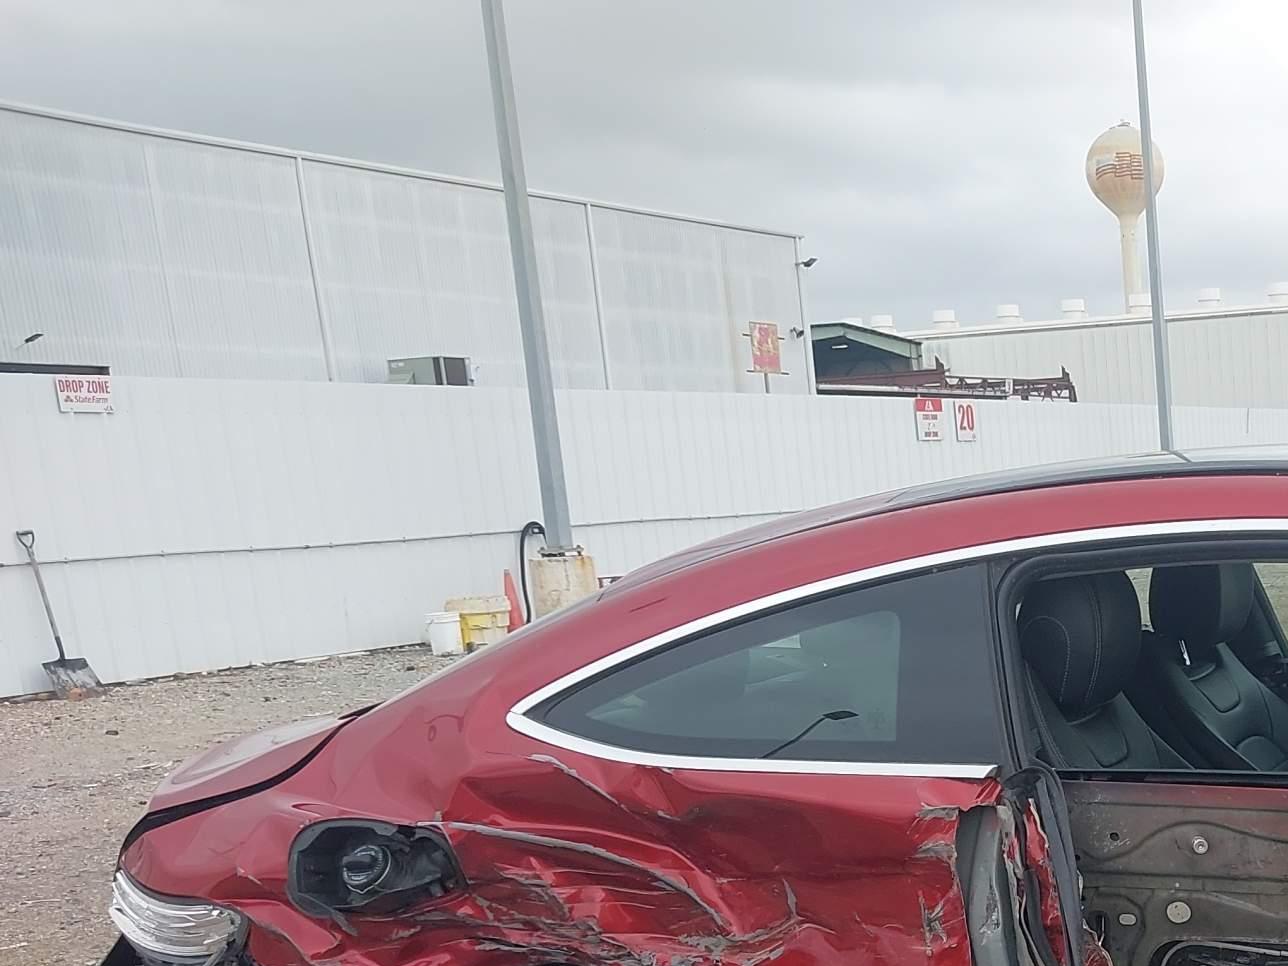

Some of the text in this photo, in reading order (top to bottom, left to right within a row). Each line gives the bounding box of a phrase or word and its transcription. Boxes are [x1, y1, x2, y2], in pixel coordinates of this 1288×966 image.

[58, 379, 110, 394] DROP ZONE
[957, 404, 975, 431] 20
